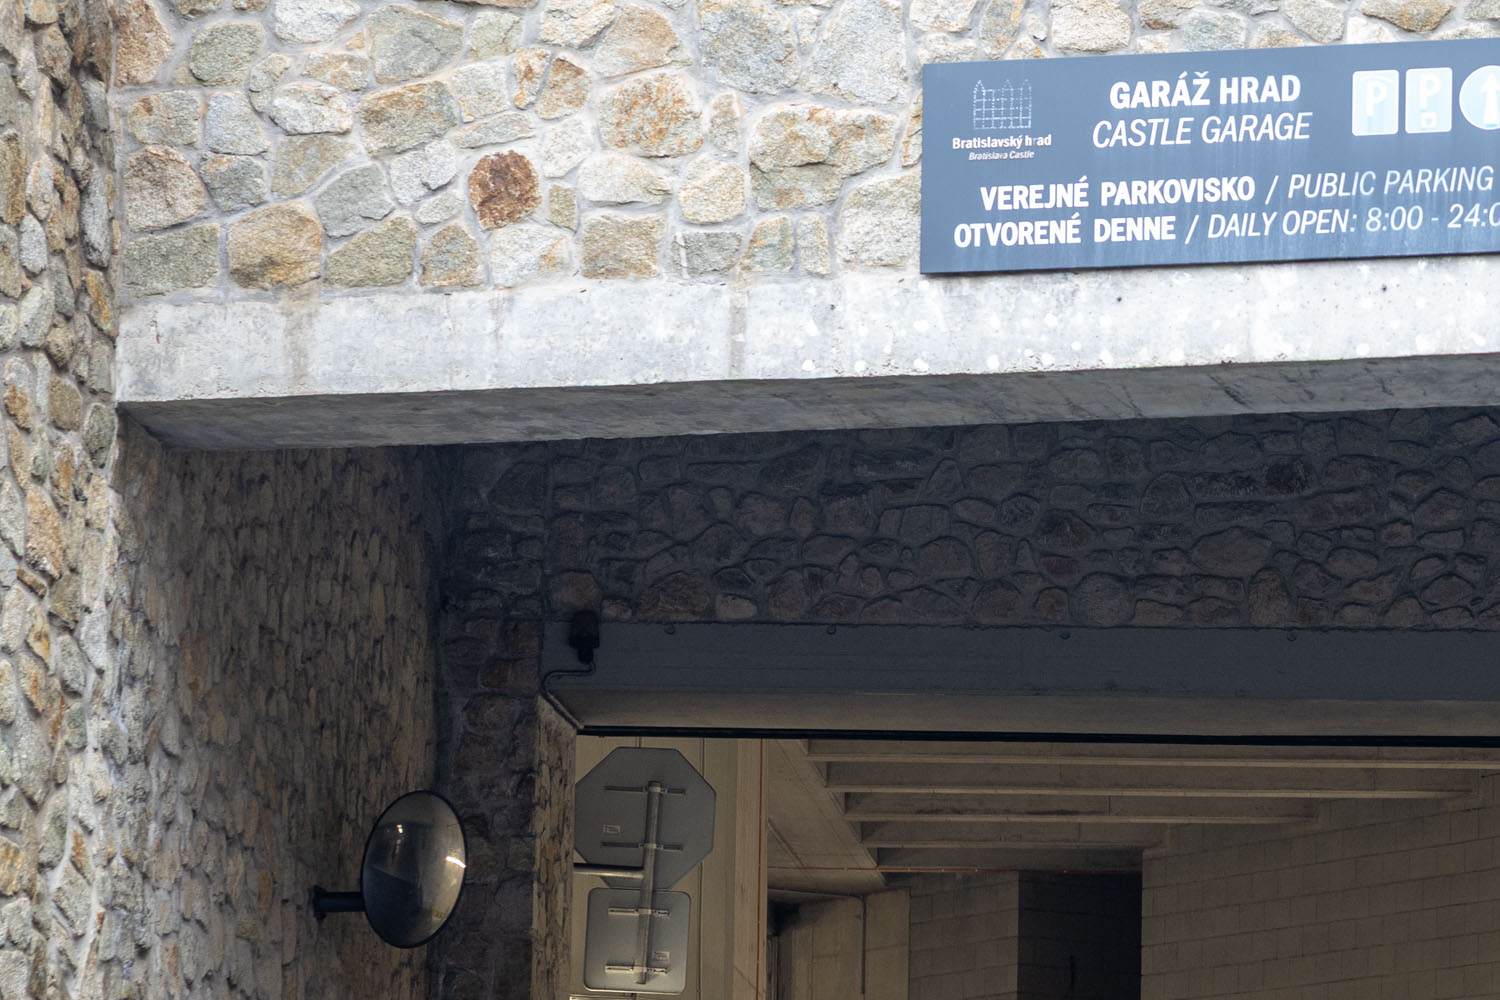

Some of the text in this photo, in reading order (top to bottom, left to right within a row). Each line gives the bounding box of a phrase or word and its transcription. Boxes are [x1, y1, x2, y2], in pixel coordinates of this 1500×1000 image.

[1109, 71, 1301, 109] GARÁŽ HRAD
[952, 134, 1052, 150] Bratislavský hrad
[1092, 112, 1313, 148] CASTLE GARAGE
[968, 150, 1035, 161] Bratislava Castle
[980, 165, 1494, 211] VEREJNÉ PARKOVISKO / PUBLIC PARKING
[954, 212, 1081, 247] OTVORENÉ
[1094, 216, 1176, 242] DENNE
[1184, 215, 1199, 245] /
[1207, 211, 1278, 238] DAILY
[1282, 208, 1357, 235] OPEN:
[1365, 205, 1423, 232] 8:00
